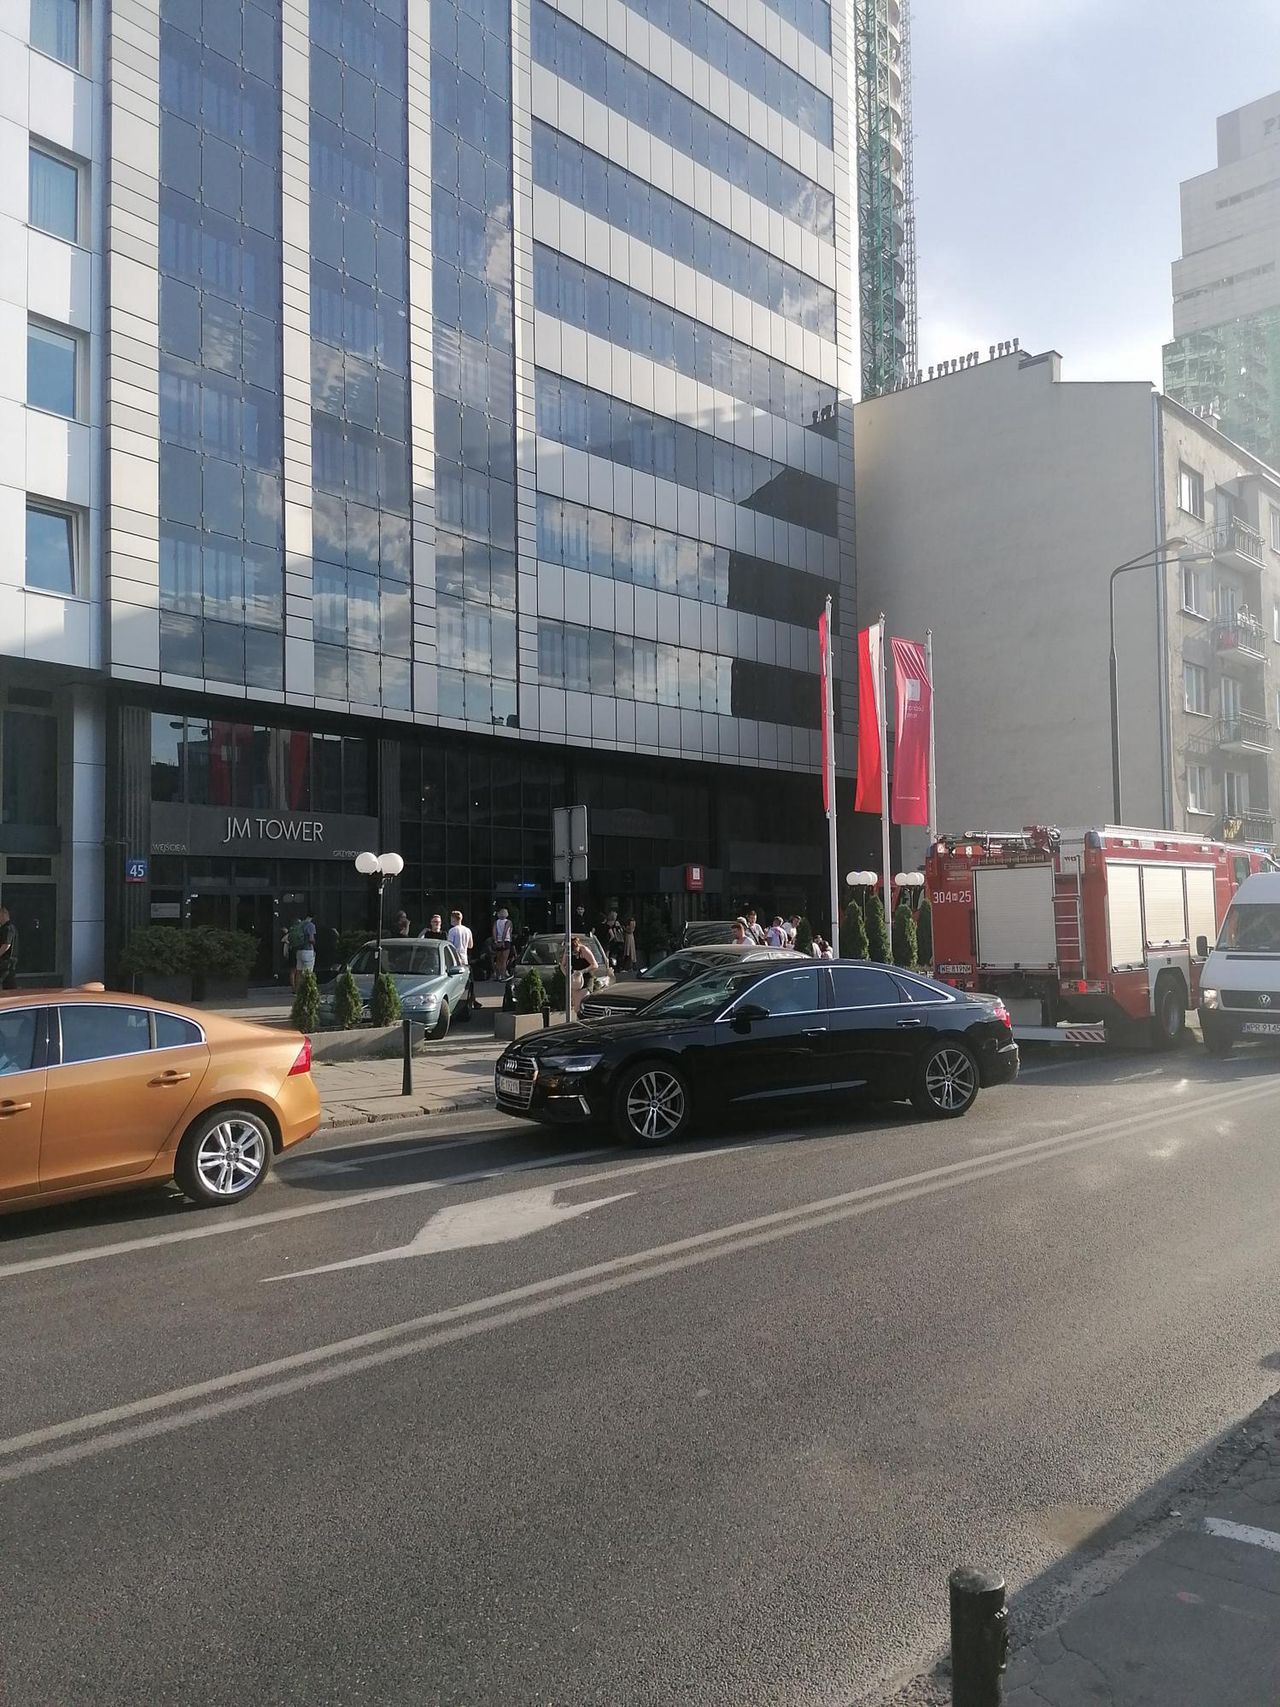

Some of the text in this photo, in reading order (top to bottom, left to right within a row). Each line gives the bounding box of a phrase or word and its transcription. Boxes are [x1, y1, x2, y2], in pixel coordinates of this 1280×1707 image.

[223, 817, 324, 843] JM TOWER
[130, 864, 144, 877] 45
[933, 891, 952, 904] 304
[958, 890, 972, 903] 25
